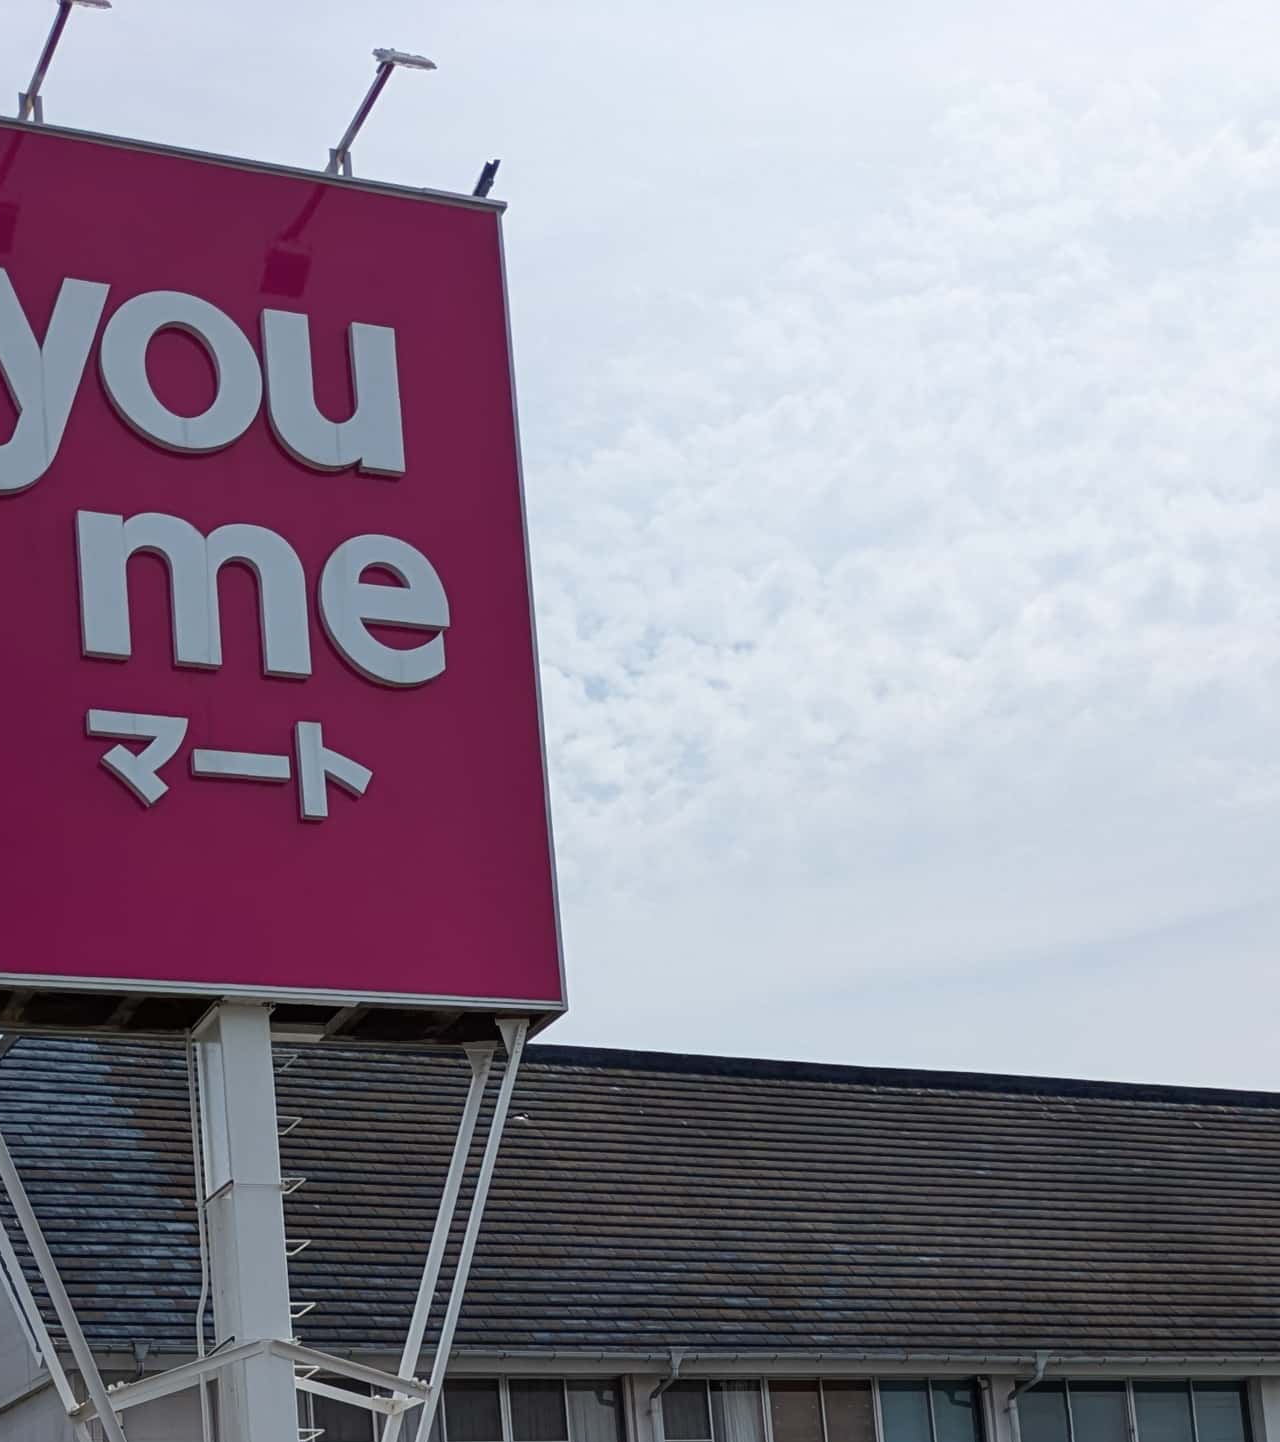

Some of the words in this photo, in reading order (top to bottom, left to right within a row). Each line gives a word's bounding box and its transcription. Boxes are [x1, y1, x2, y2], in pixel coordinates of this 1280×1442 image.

[75, 509, 450, 687] me
[86, 708, 373, 821] マート
